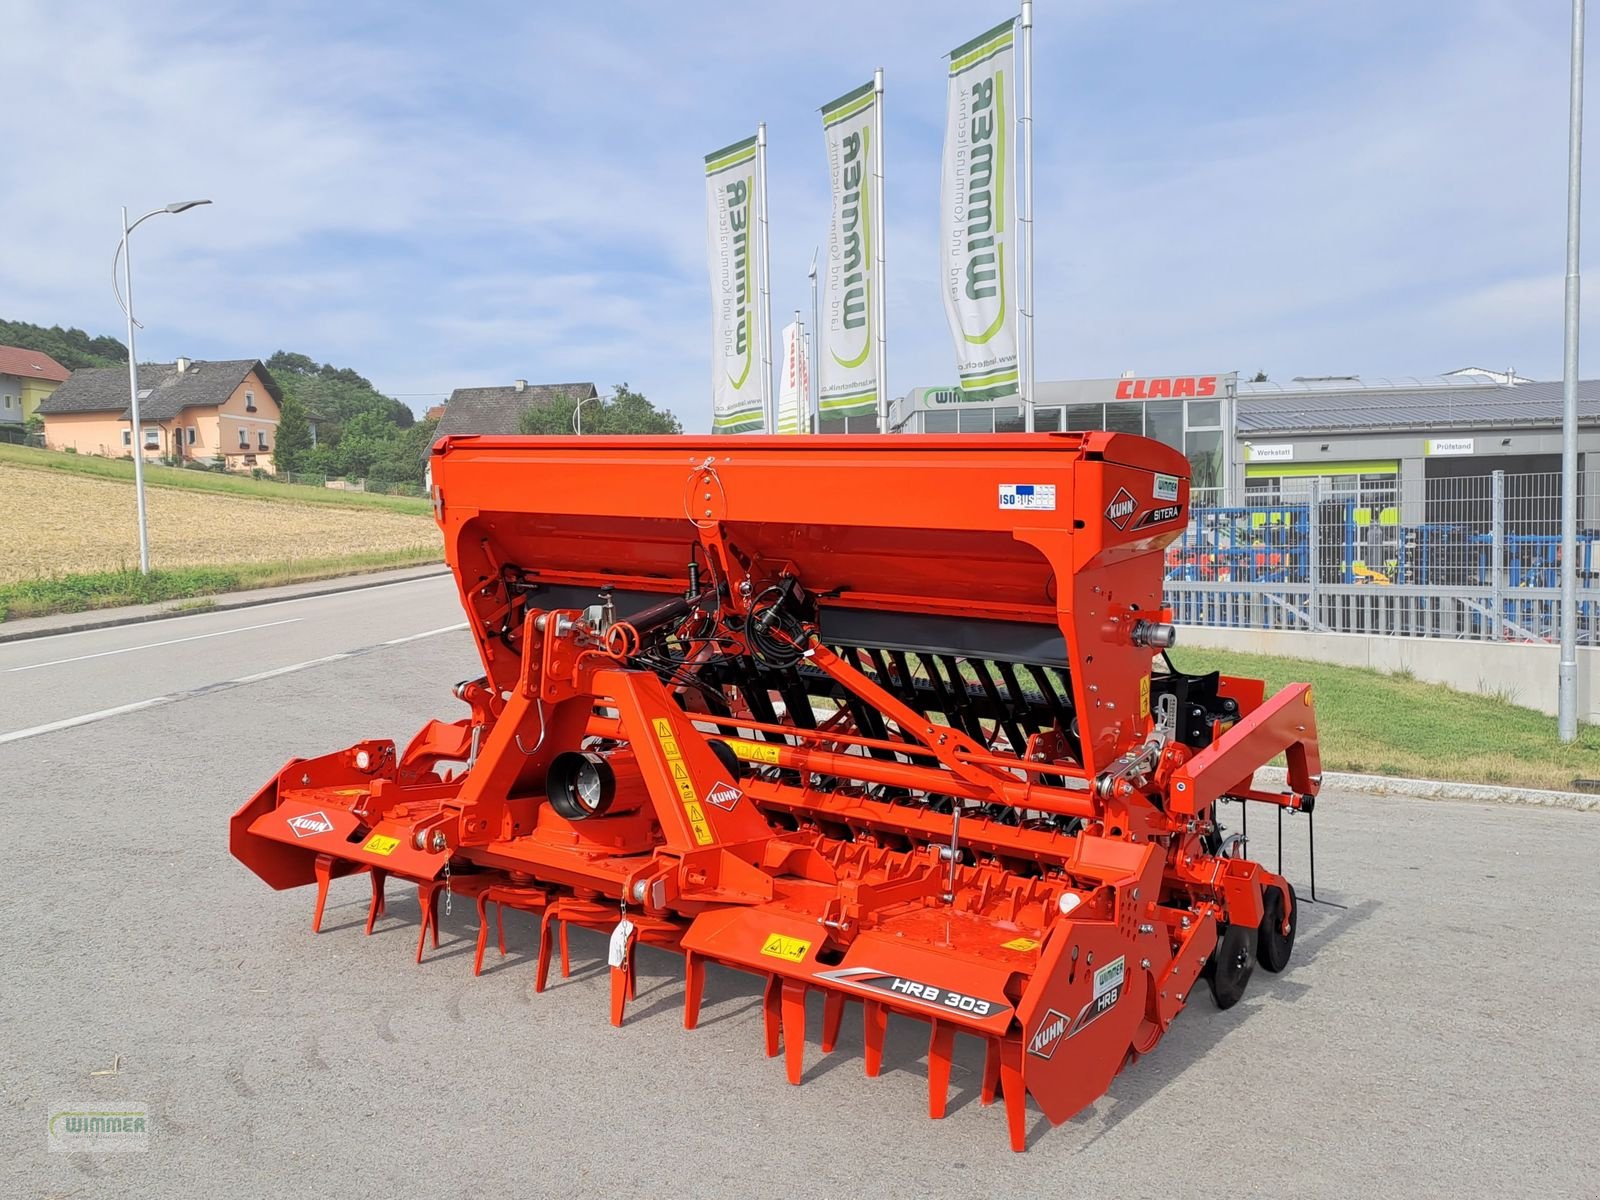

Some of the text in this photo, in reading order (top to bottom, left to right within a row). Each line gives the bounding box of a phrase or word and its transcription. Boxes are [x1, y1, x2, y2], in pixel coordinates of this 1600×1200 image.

[1116, 377, 1217, 400] CLAAS
[1110, 500, 1134, 519] KUHN
[1153, 506, 1179, 521] SITERA
[711, 789, 738, 804] KUHN
[293, 818, 328, 832] KUHN
[891, 978, 991, 1015] HRB 303
[1097, 988, 1118, 1012] HRB
[1035, 1018, 1064, 1052] KUHN
